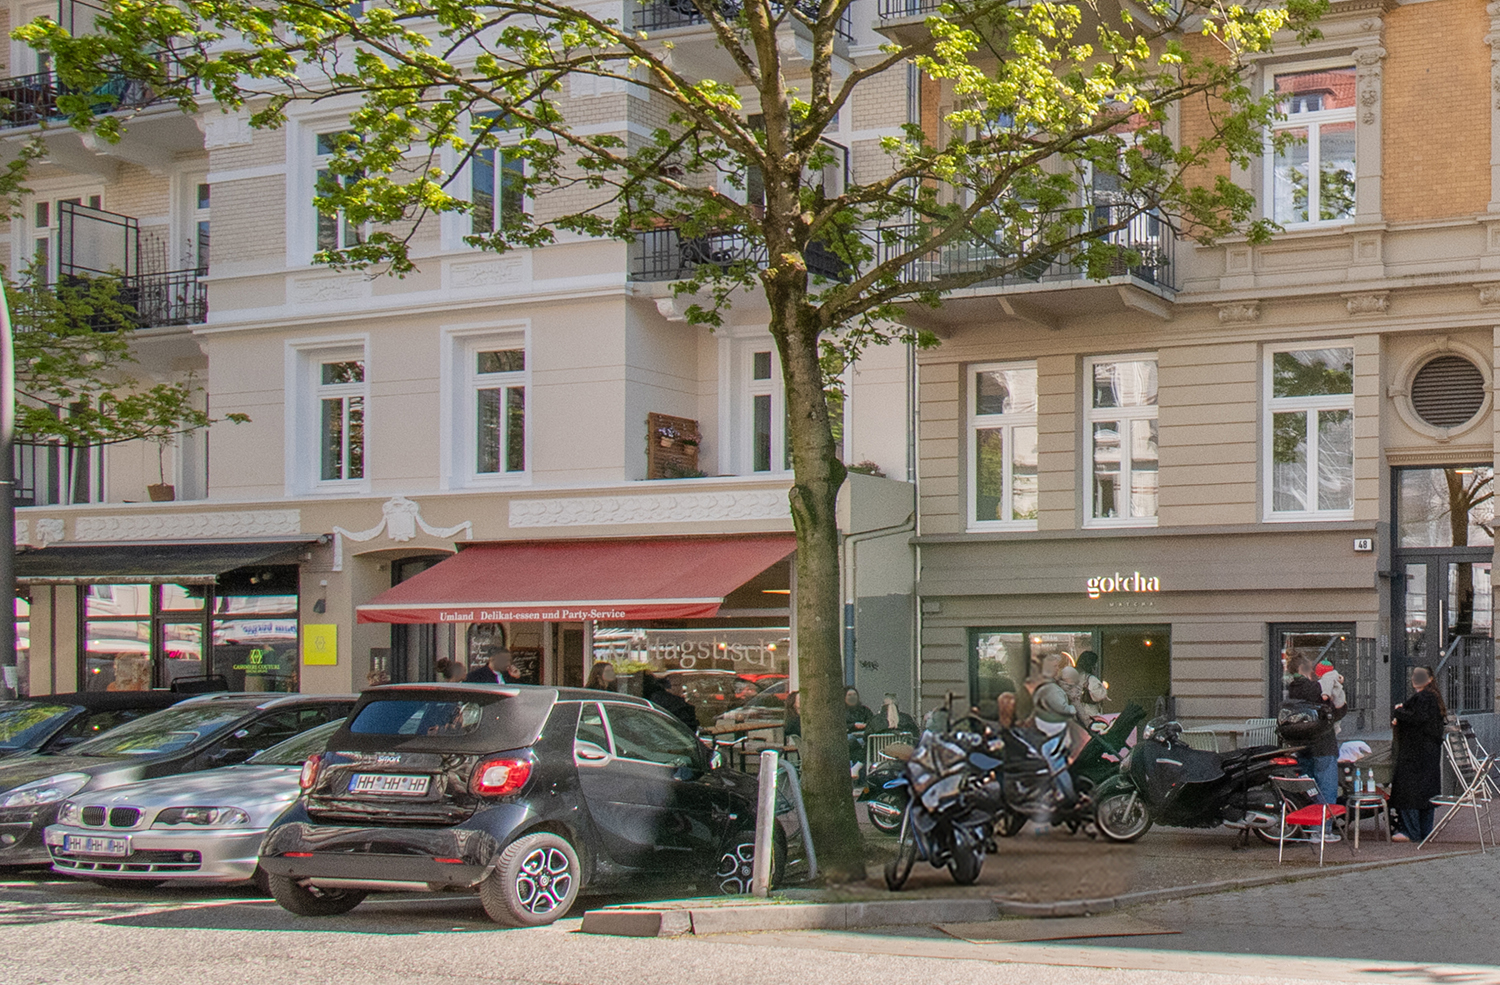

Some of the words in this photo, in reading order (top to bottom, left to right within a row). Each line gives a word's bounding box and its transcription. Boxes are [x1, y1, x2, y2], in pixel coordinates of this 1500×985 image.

[1359, 540, 1367, 549] 48
[1086, 571, 1160, 599] gotcha
[440, 612, 474, 621] Umland
[481, 610, 540, 621] Delikat-essen
[542, 610, 559, 619] und
[562, 609, 626, 621] Party-Service
[608, 634, 777, 669] Mittagstisch
[357, 776, 376, 789] HH
[383, 776, 401, 790] HH
